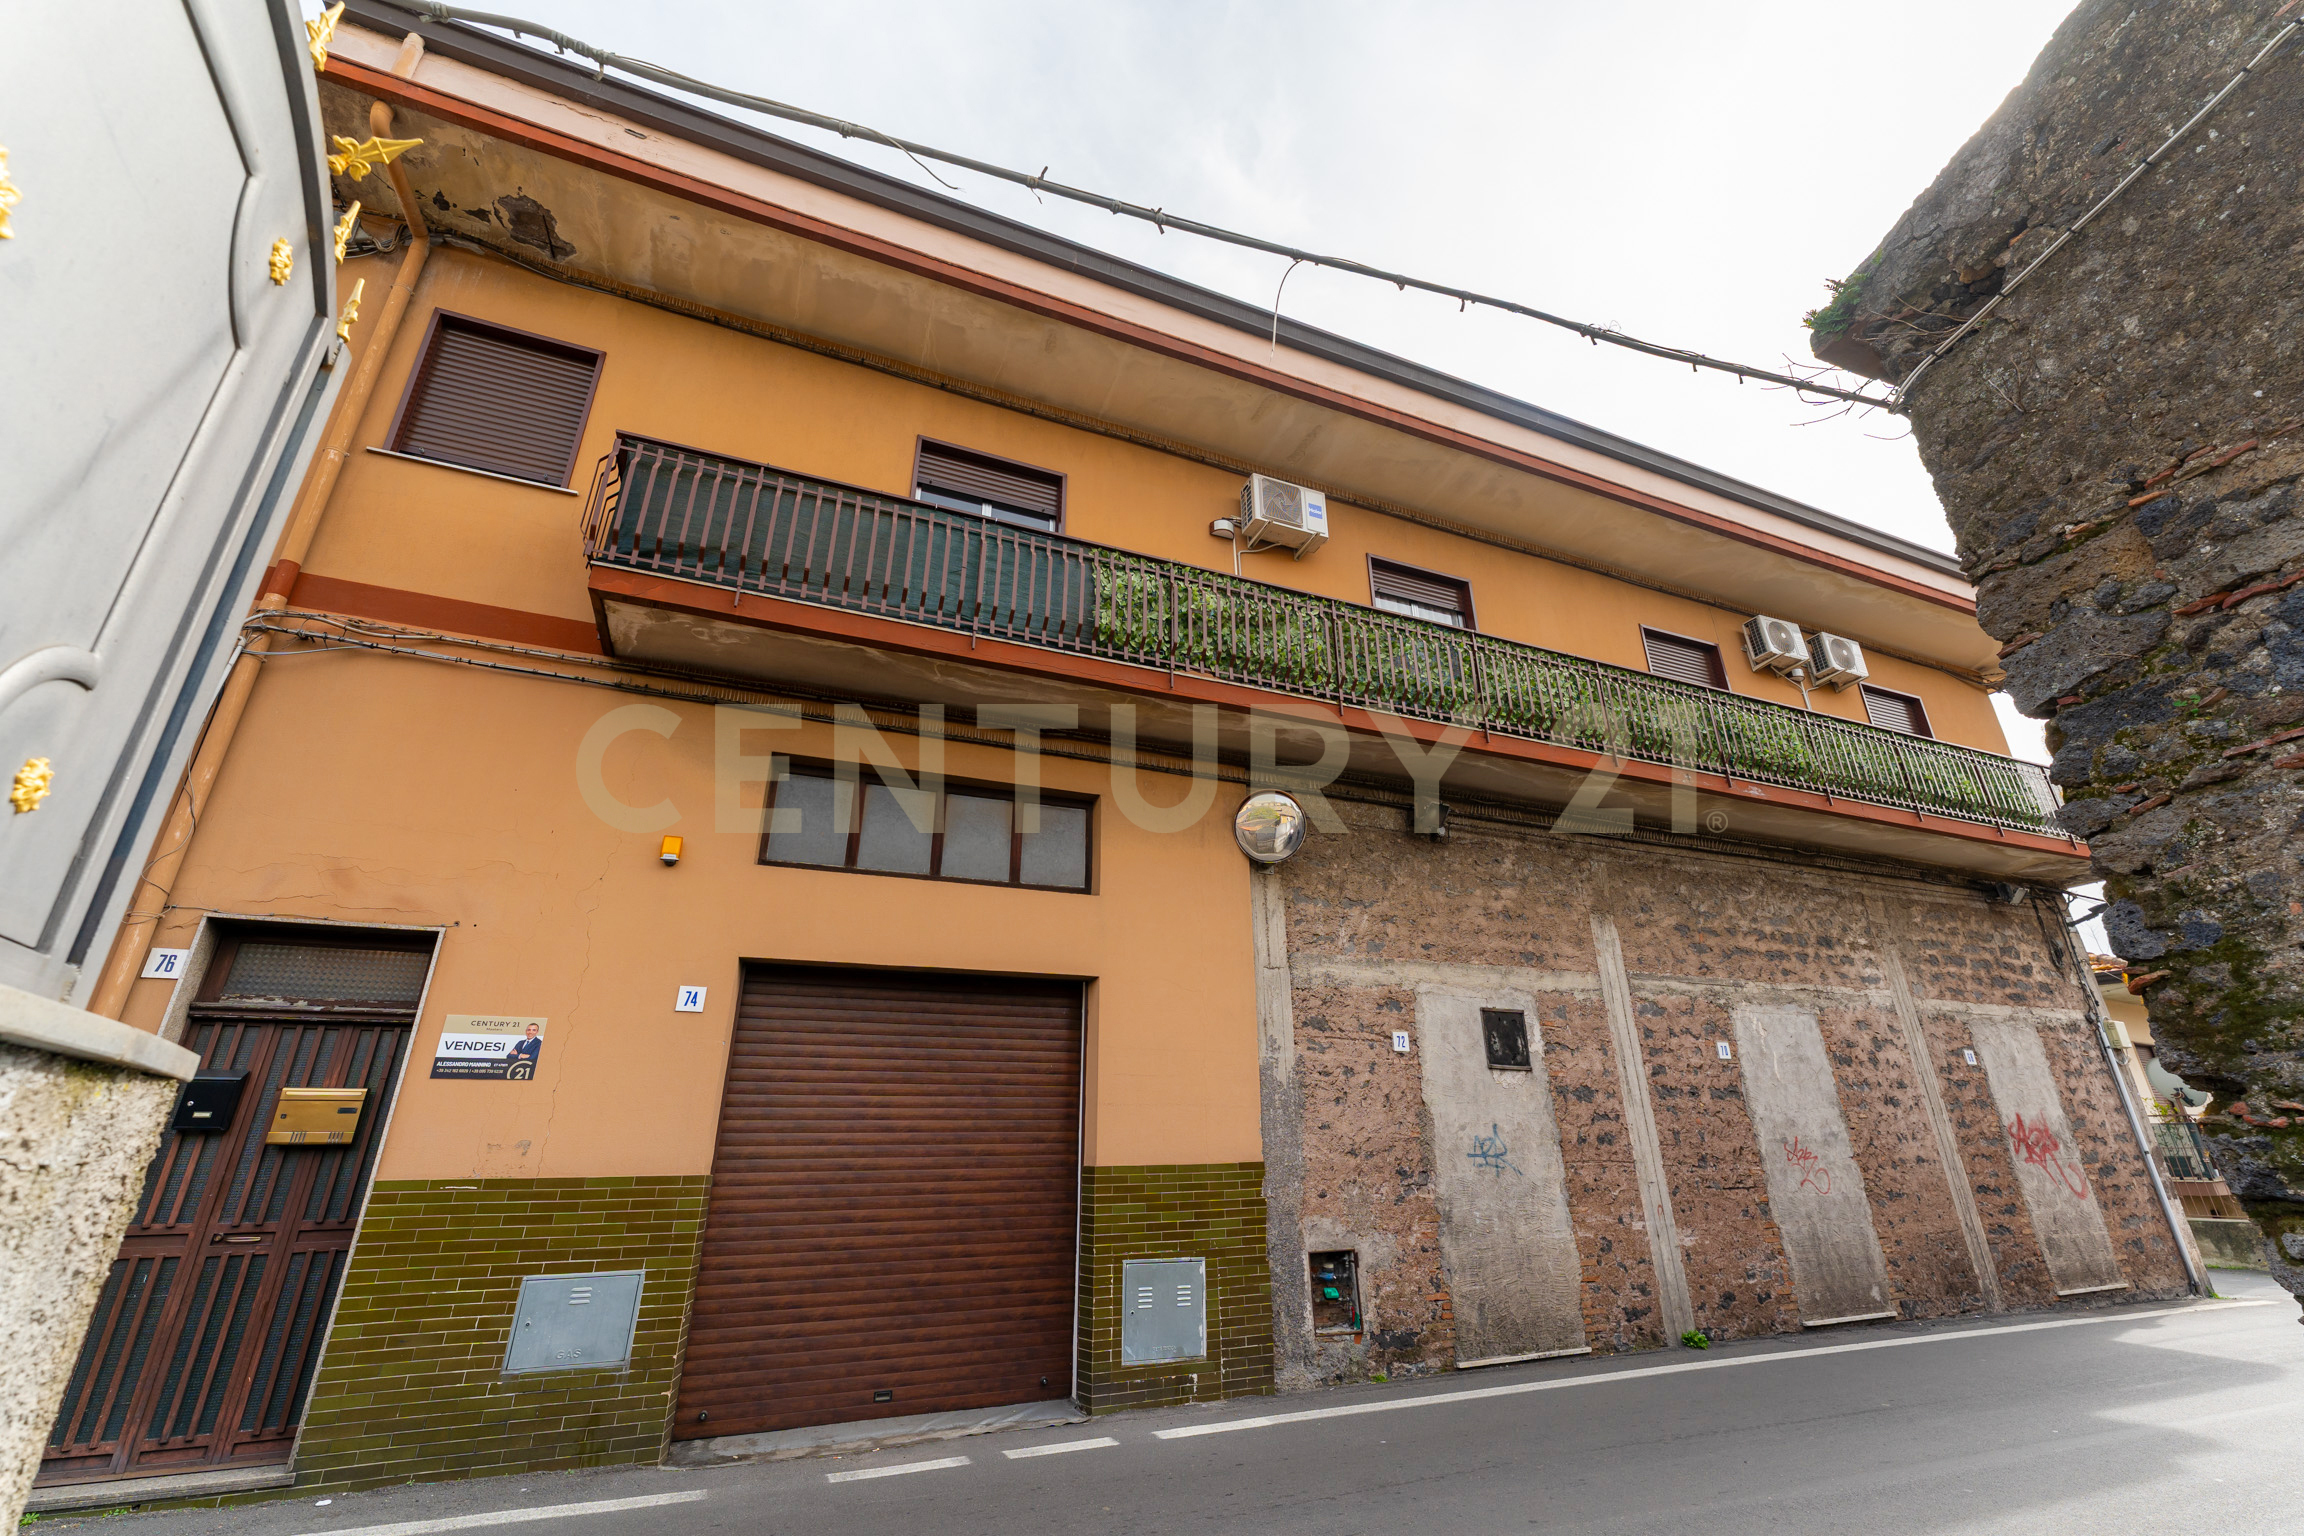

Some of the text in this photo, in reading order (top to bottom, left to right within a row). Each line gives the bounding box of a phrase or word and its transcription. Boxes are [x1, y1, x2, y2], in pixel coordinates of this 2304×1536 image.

[154, 954, 178, 973] 76
[683, 990, 698, 1007] 74
[470, 1020, 511, 1028] CENTURY
[444, 1040, 506, 1052] VENDESI
[1396, 1035, 1406, 1048] 72
[514, 1067, 531, 1080] 21
[555, 1348, 583, 1360] GAS
